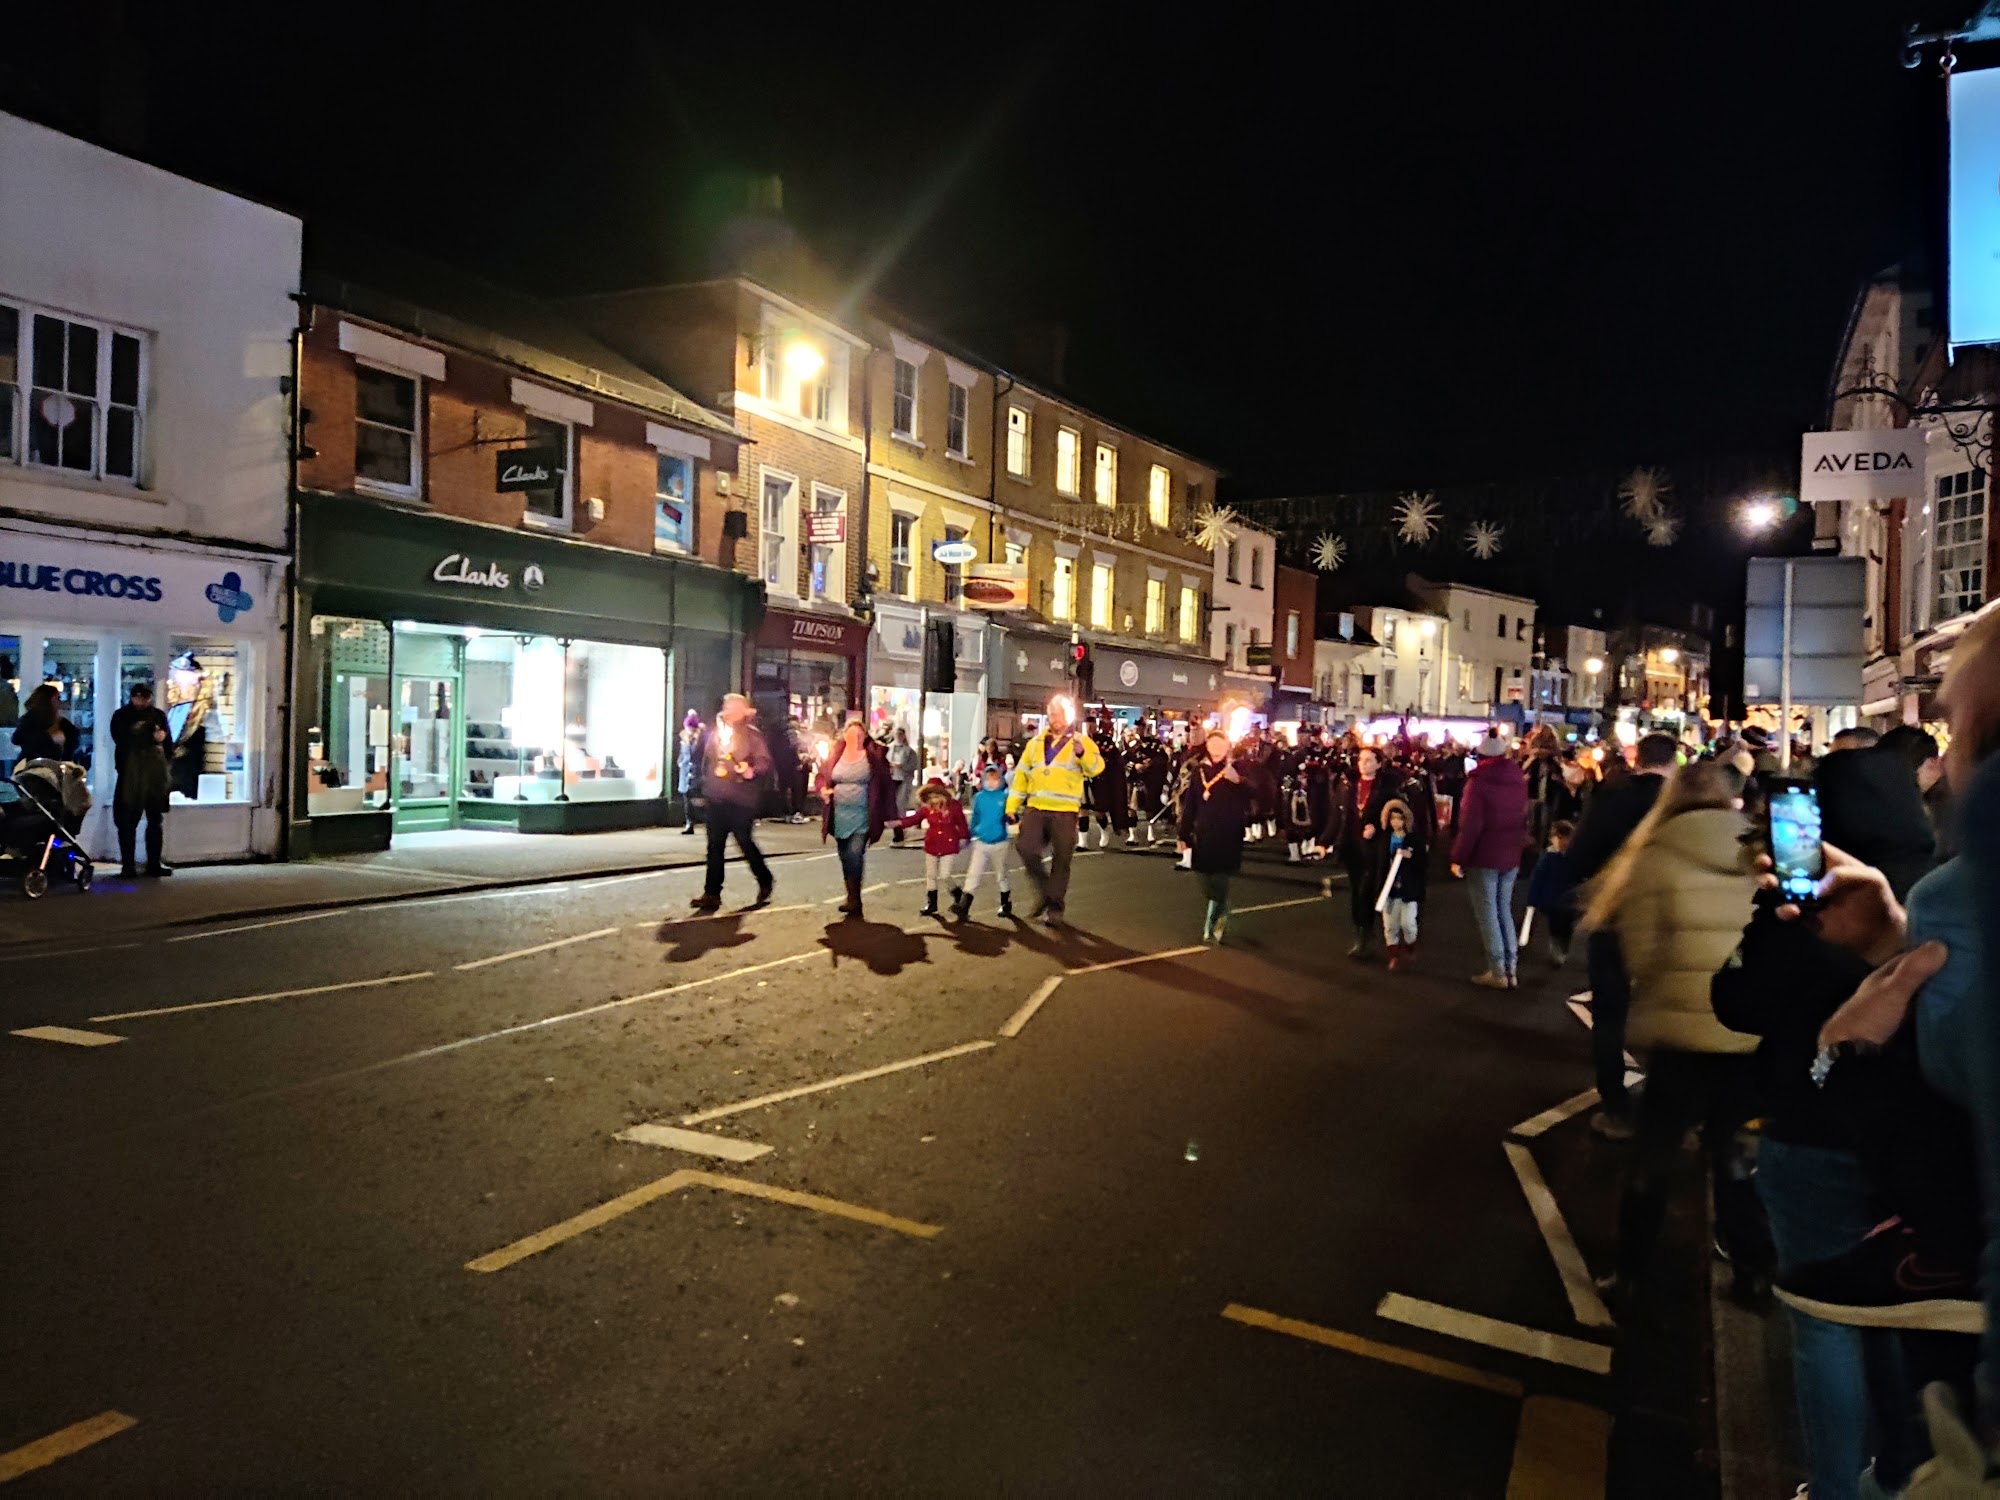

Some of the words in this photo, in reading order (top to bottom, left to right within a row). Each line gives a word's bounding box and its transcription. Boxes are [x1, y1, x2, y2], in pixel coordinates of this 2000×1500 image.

[1814, 452, 1913, 472] AVEDA
[501, 465, 549, 482] Clarks
[433, 554, 509, 588] Clarks
[63, 568, 162, 602] CROSS
[792, 620, 845, 639] TIMPSON
